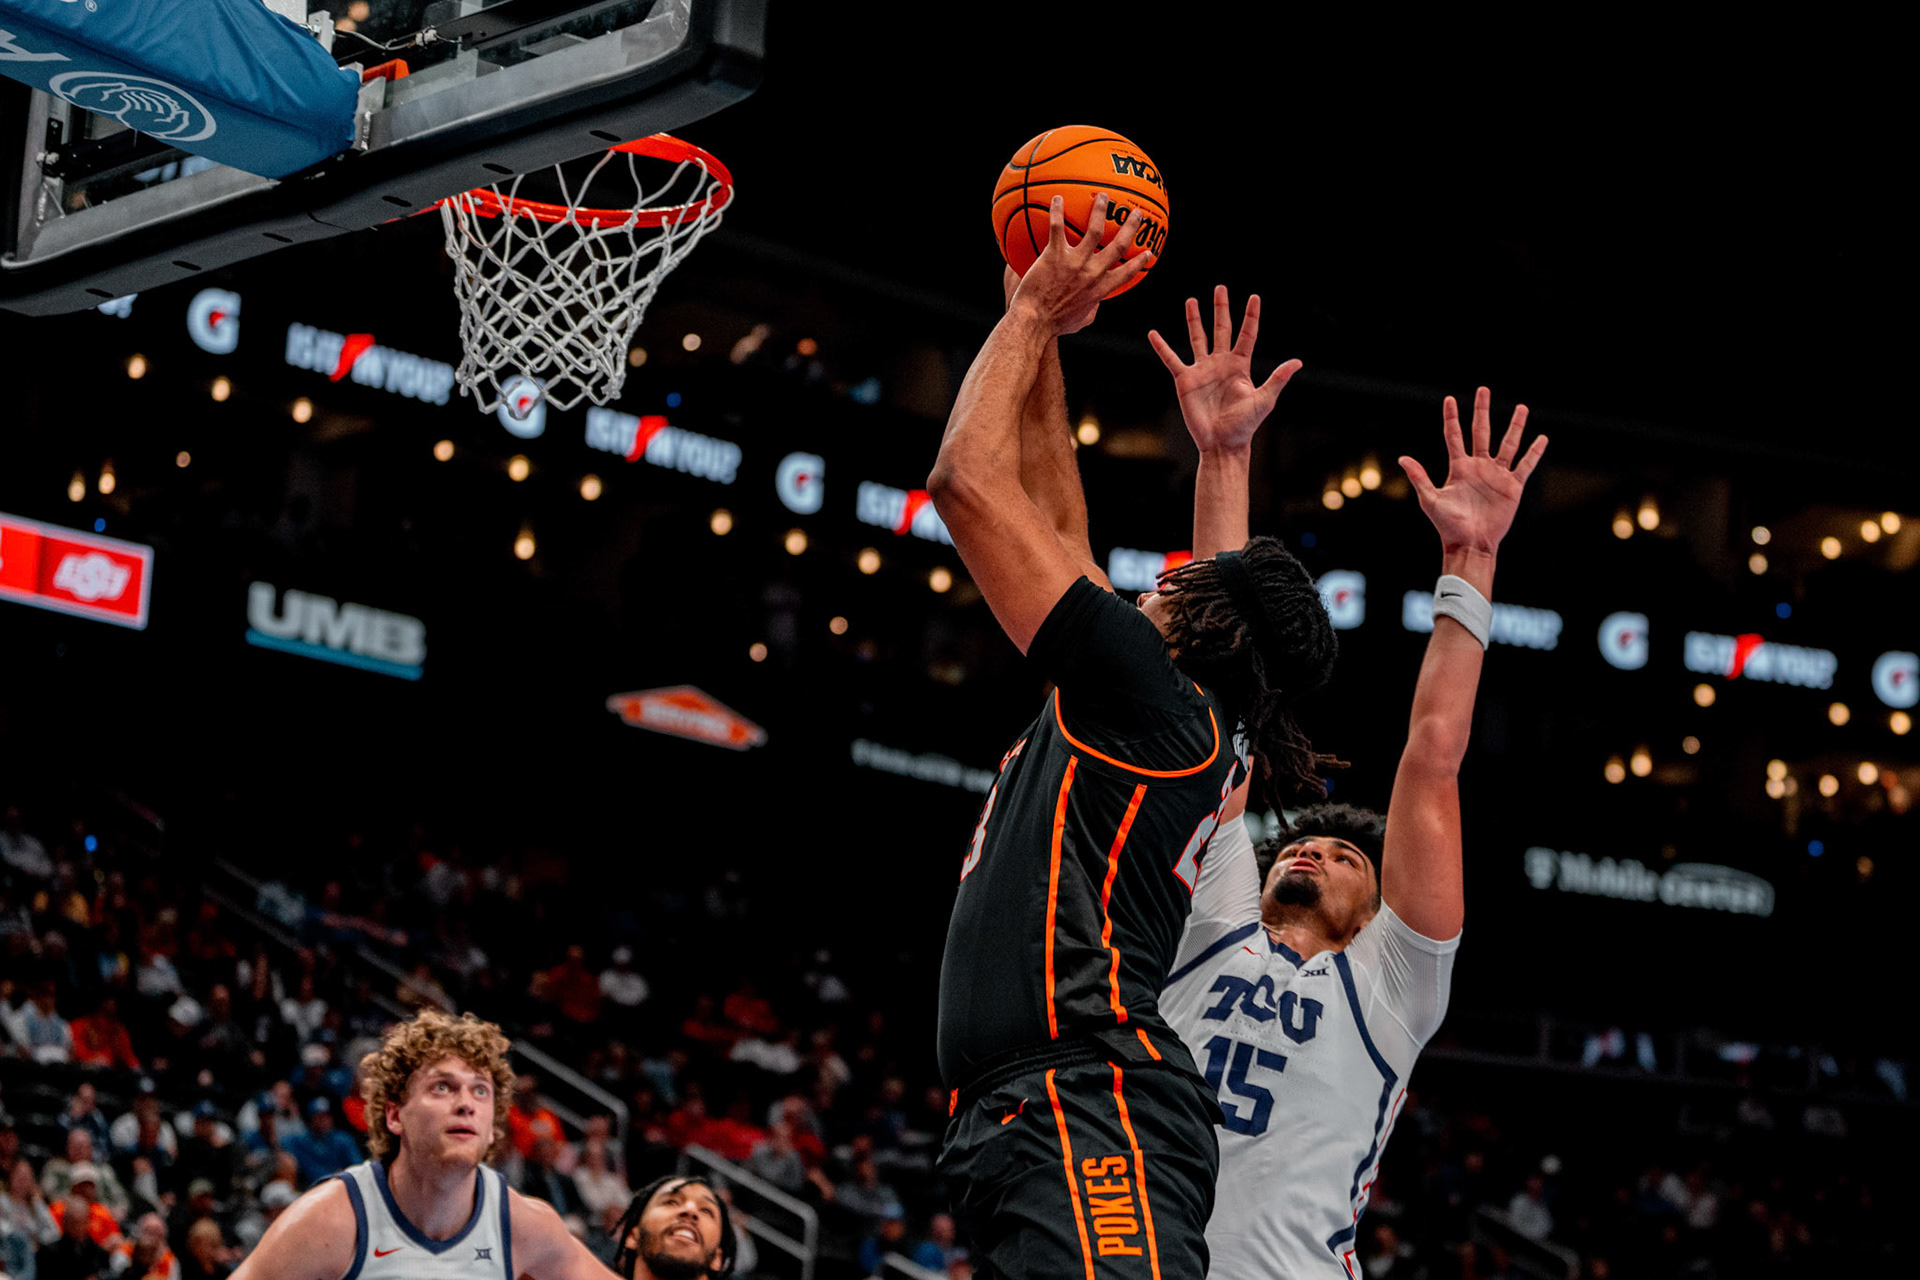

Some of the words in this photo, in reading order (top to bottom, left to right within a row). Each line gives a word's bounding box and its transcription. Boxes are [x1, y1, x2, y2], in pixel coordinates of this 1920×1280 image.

[247, 581, 427, 666] UMB
[1202, 974, 1324, 1046] TCU
[1202, 1035, 1288, 1138] 15
[1081, 1155, 1143, 1256] POKES
